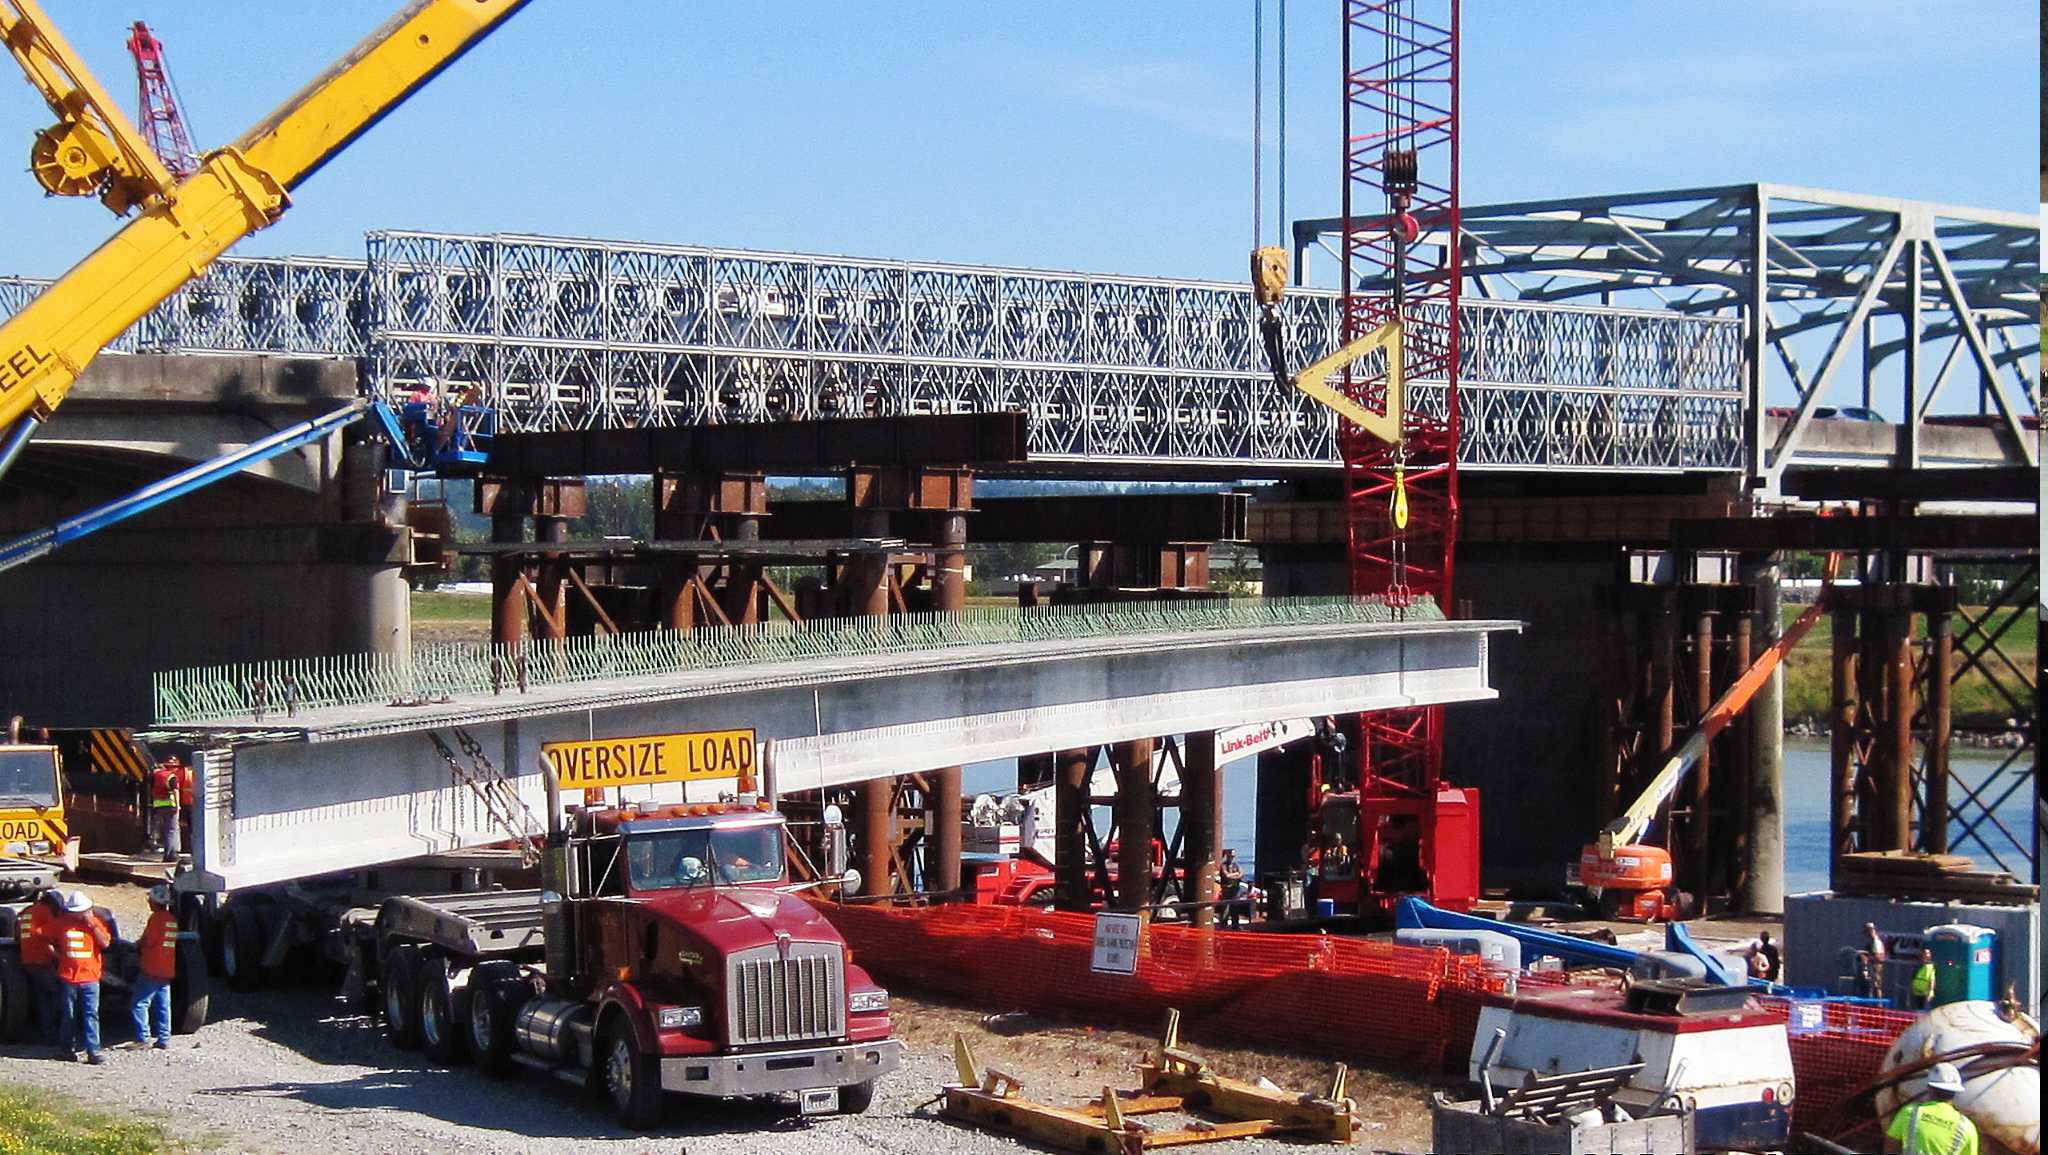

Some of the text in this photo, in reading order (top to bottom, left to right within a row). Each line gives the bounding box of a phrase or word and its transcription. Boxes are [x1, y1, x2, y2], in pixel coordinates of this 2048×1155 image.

[1221, 726, 1271, 754] Link-Belt
[688, 737, 752, 773] LOAD
[0, 821, 40, 840] OAD
